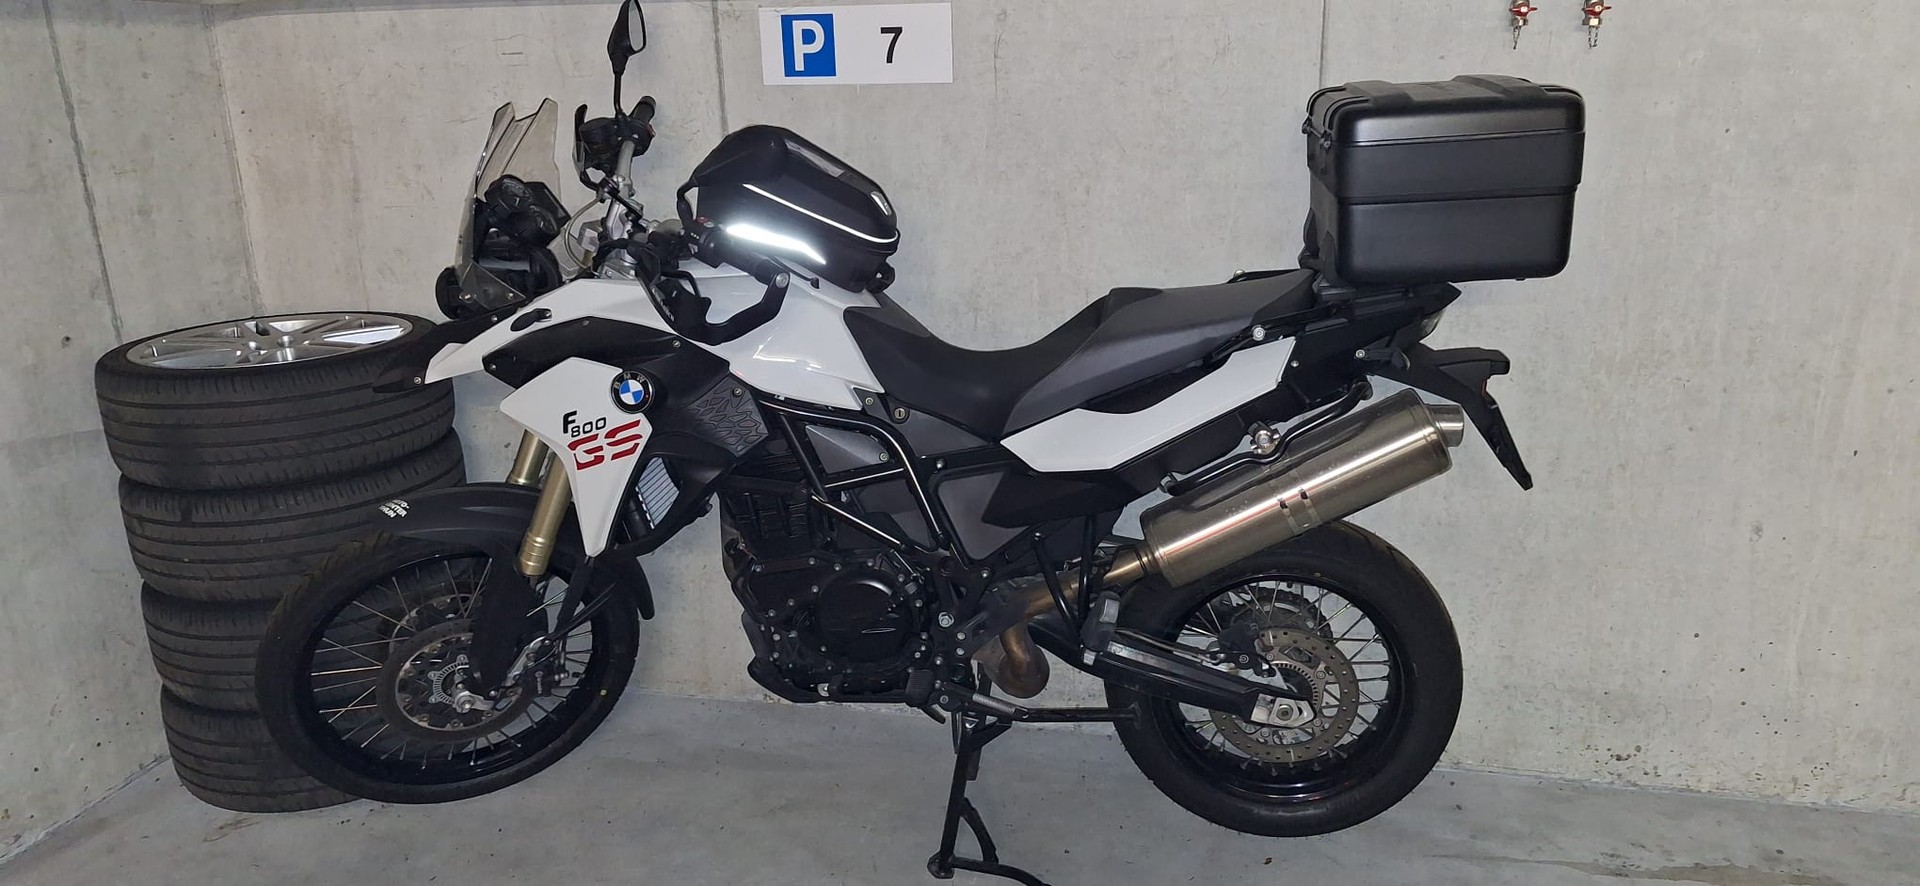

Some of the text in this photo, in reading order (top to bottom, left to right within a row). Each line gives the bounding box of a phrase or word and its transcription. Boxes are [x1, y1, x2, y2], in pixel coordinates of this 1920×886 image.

[792, 19, 903, 71] P 7
[614, 371, 646, 389] BMW
[562, 410, 607, 438] F 800
[567, 419, 643, 471] GS
